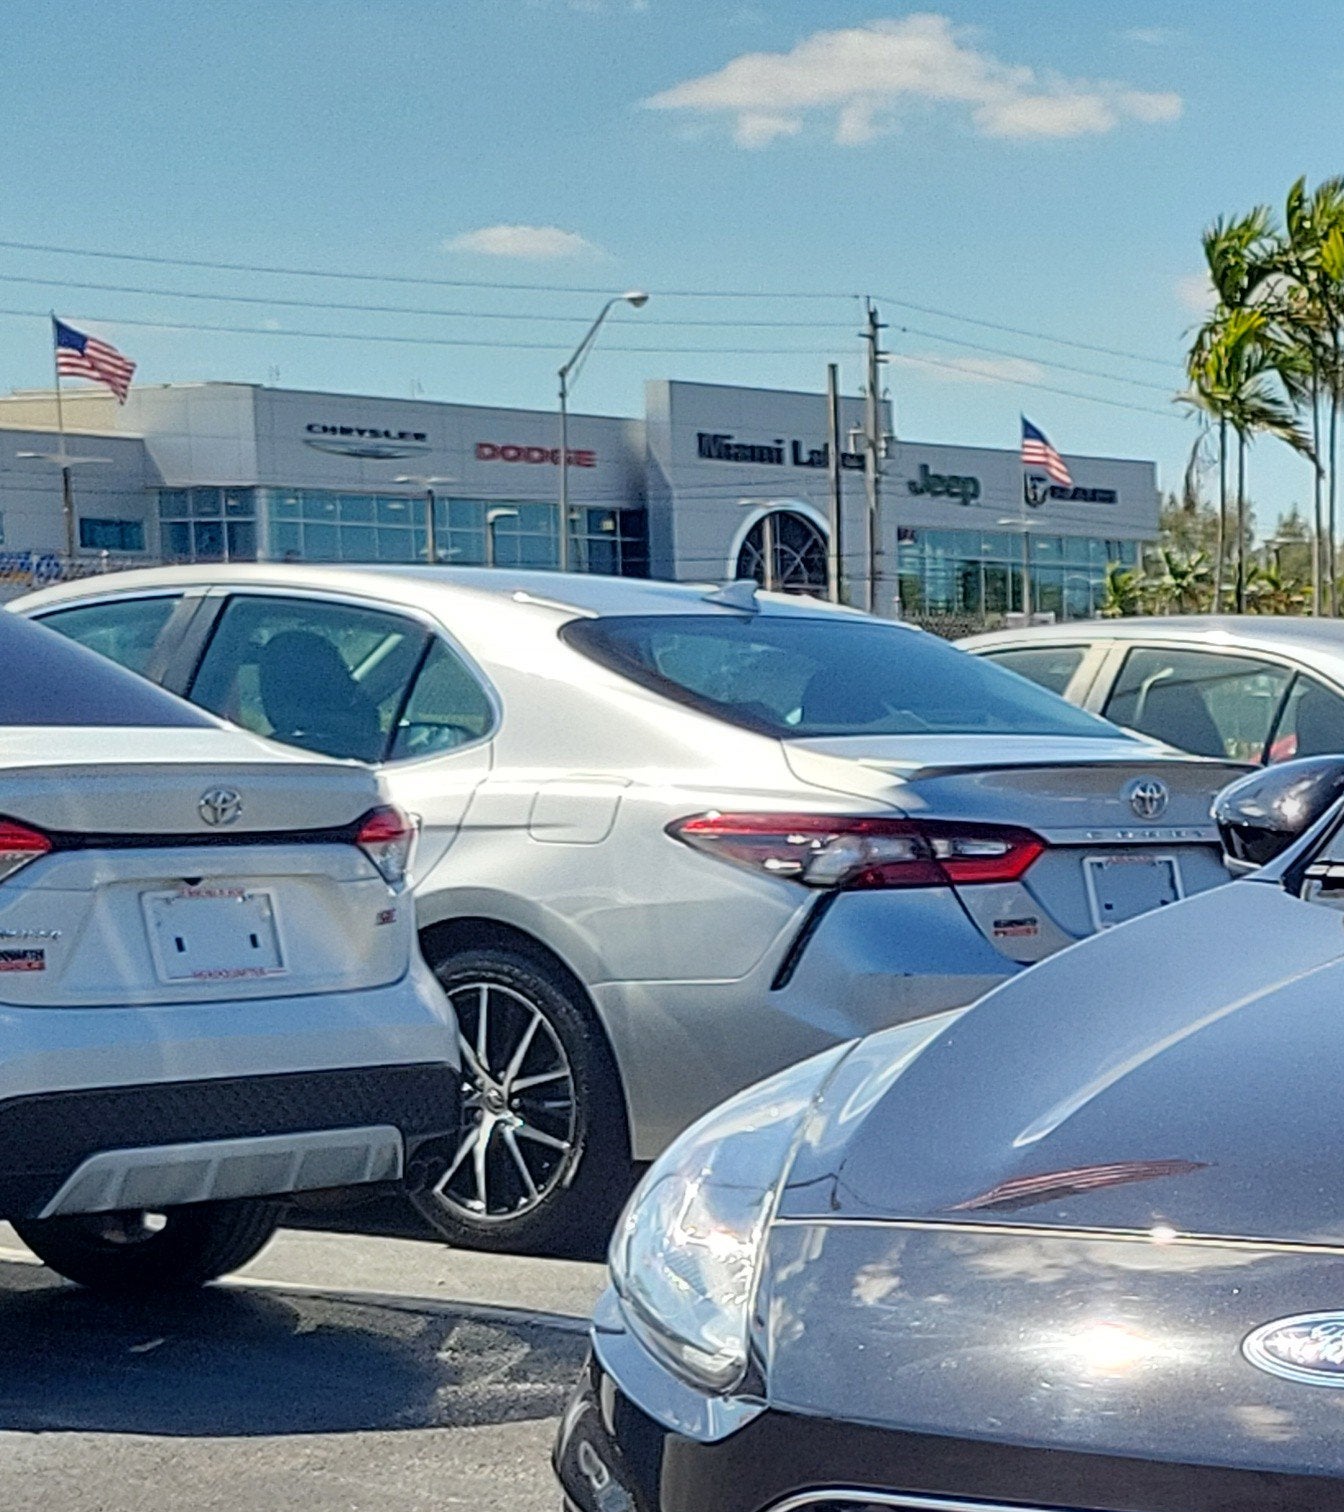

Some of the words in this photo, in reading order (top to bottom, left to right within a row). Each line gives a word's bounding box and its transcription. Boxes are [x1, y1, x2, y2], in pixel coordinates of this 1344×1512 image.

[306, 423, 428, 442] CHRYSLER
[474, 442, 597, 468] DODGE
[697, 432, 784, 466] Miami
[907, 463, 981, 506] Jeep
